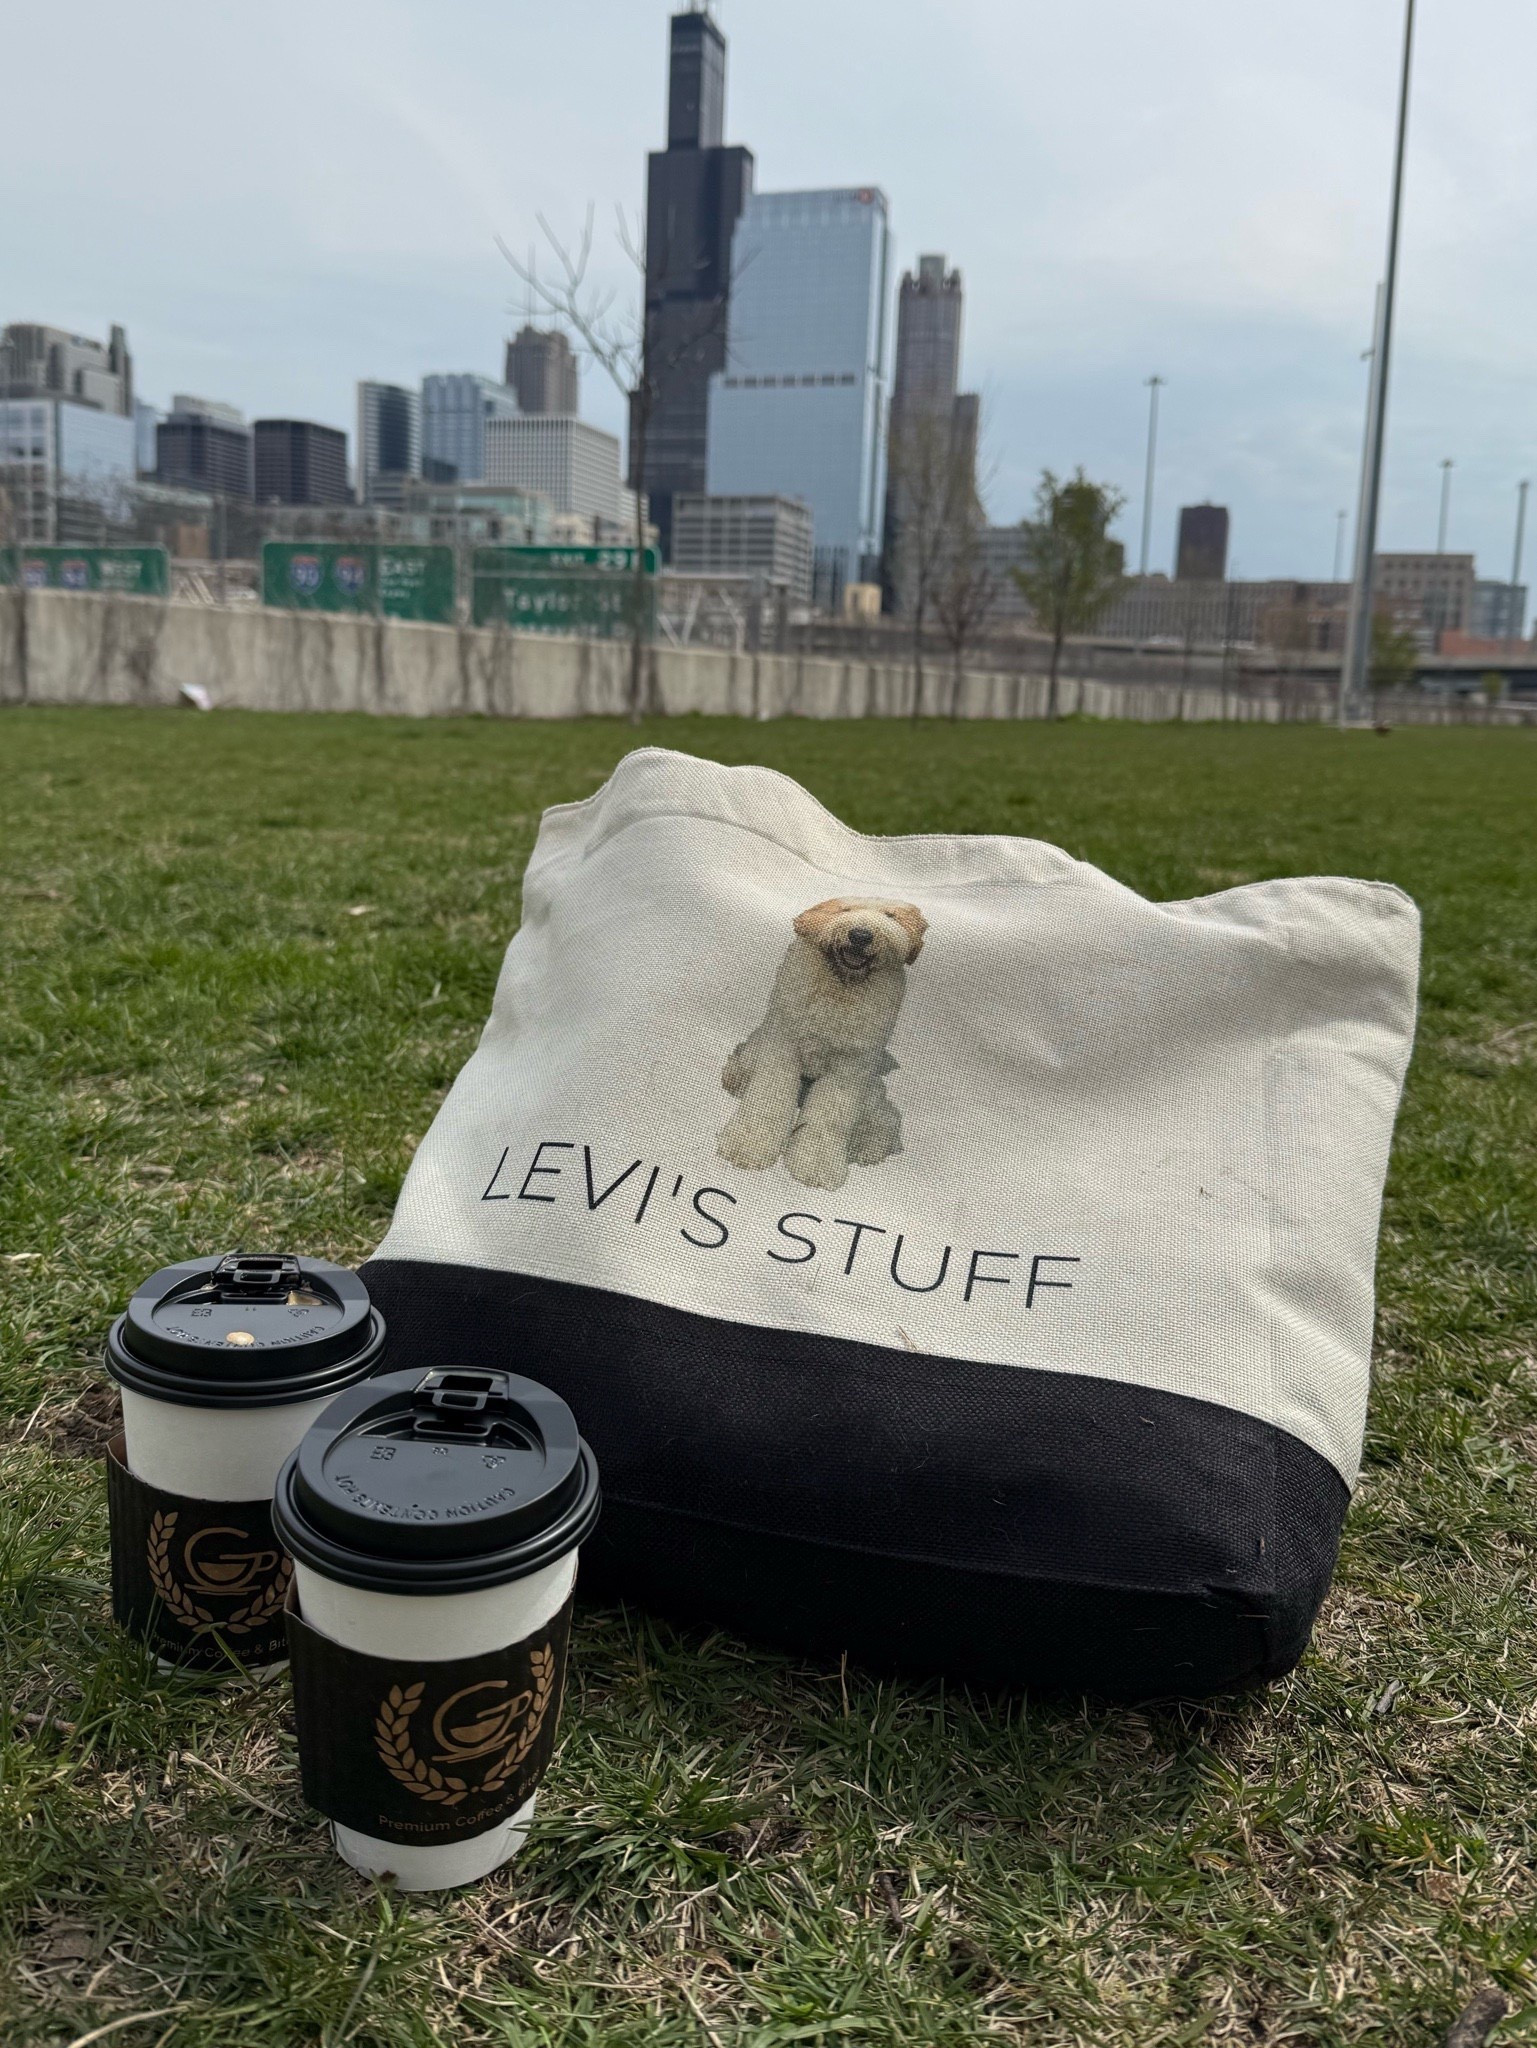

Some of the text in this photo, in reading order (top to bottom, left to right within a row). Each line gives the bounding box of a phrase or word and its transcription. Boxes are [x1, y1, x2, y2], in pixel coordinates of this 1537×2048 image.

[481, 1141, 1081, 1309] LEVI'S STUFF
[353, 1493, 439, 1520] CONTENTS
[445, 1486, 516, 1519] CAUTION
[378, 1814, 451, 1833] Premium
[455, 1802, 504, 1828] Coffee
